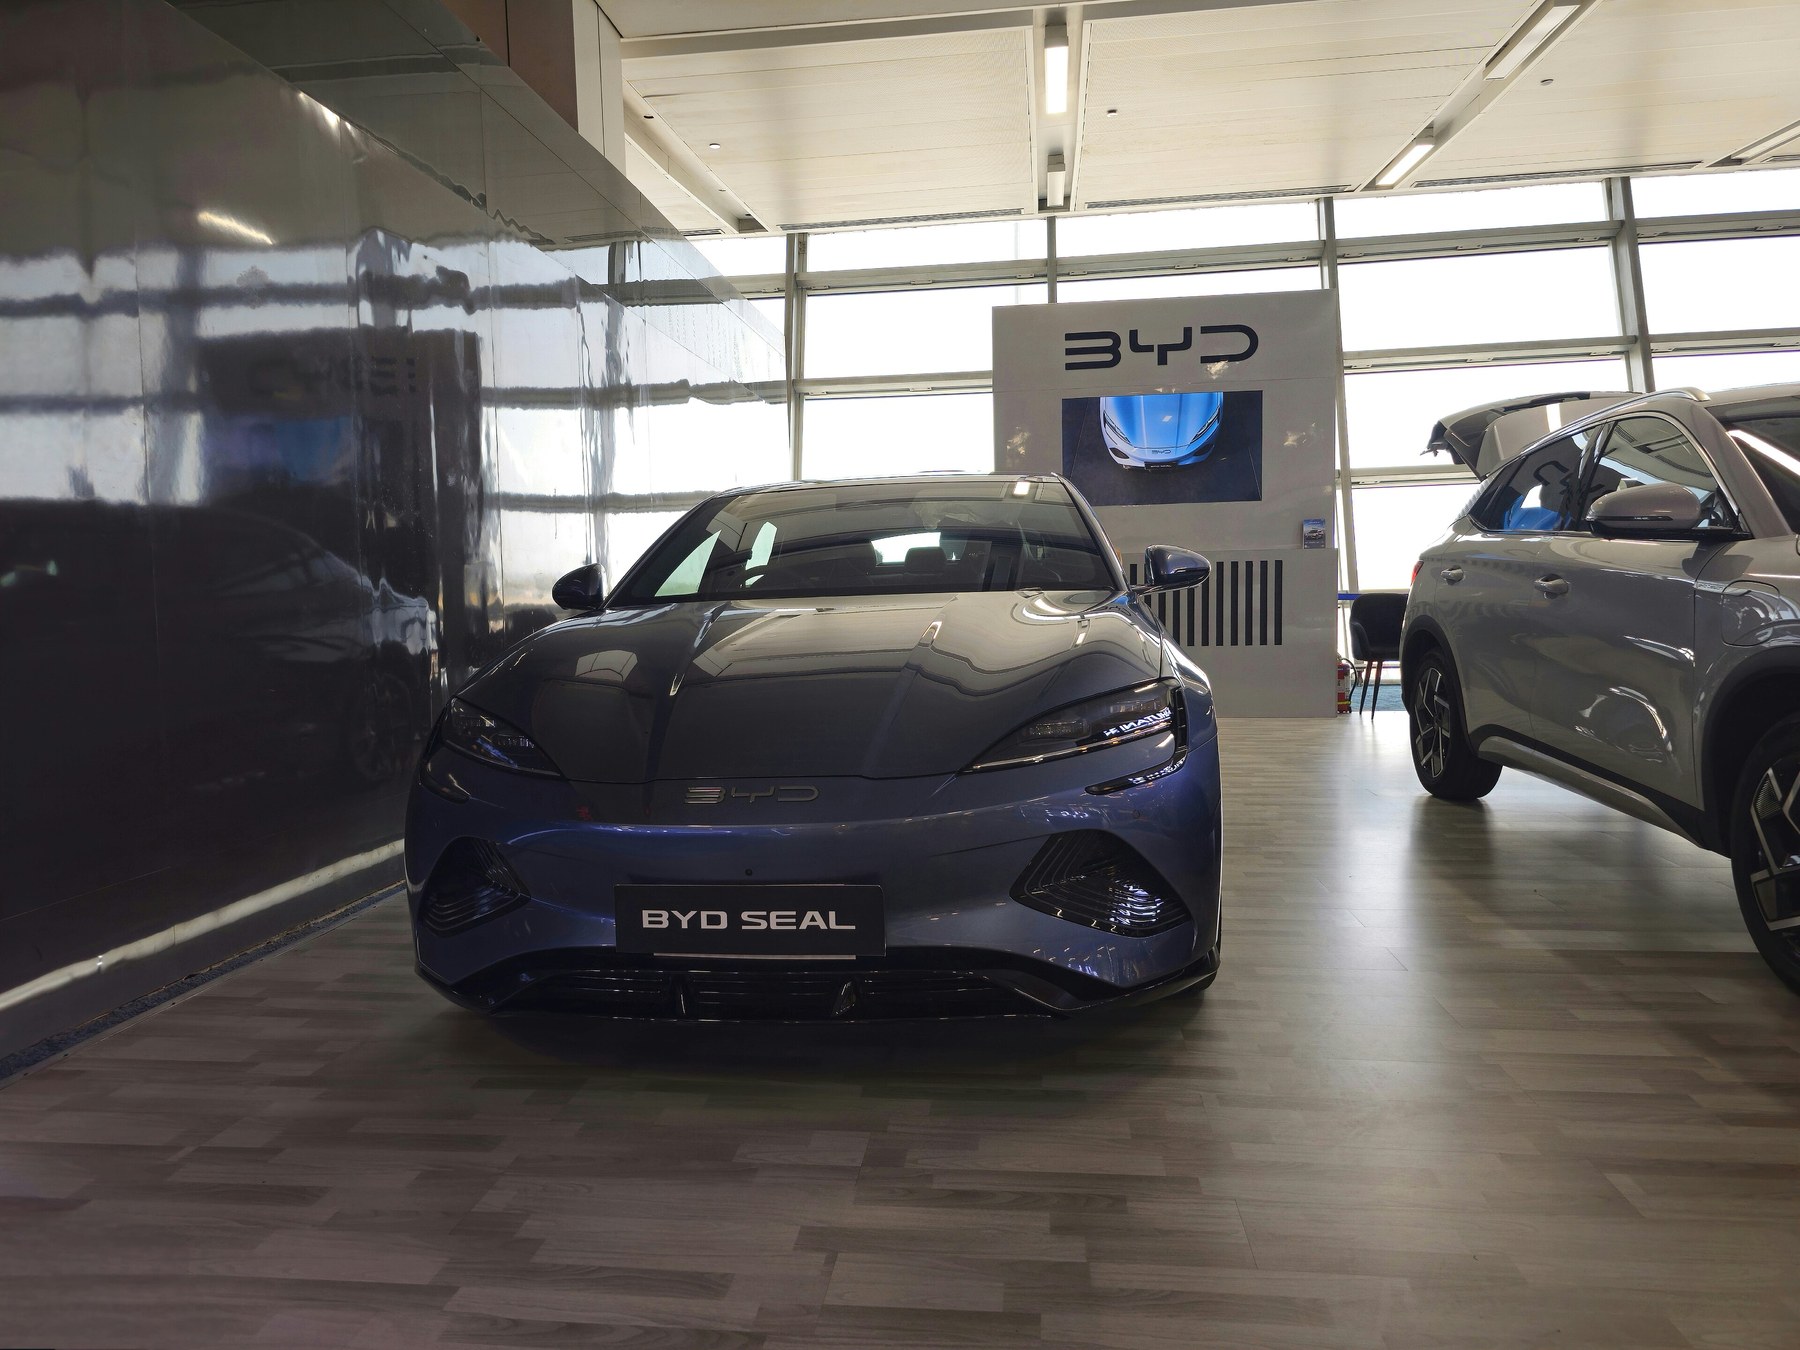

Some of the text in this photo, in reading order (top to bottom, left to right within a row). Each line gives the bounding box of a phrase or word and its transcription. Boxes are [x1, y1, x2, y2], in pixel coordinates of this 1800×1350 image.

[1065, 324, 1259, 370] BYD
[686, 786, 819, 804] BYD
[642, 909, 856, 930] BYD SEAL
